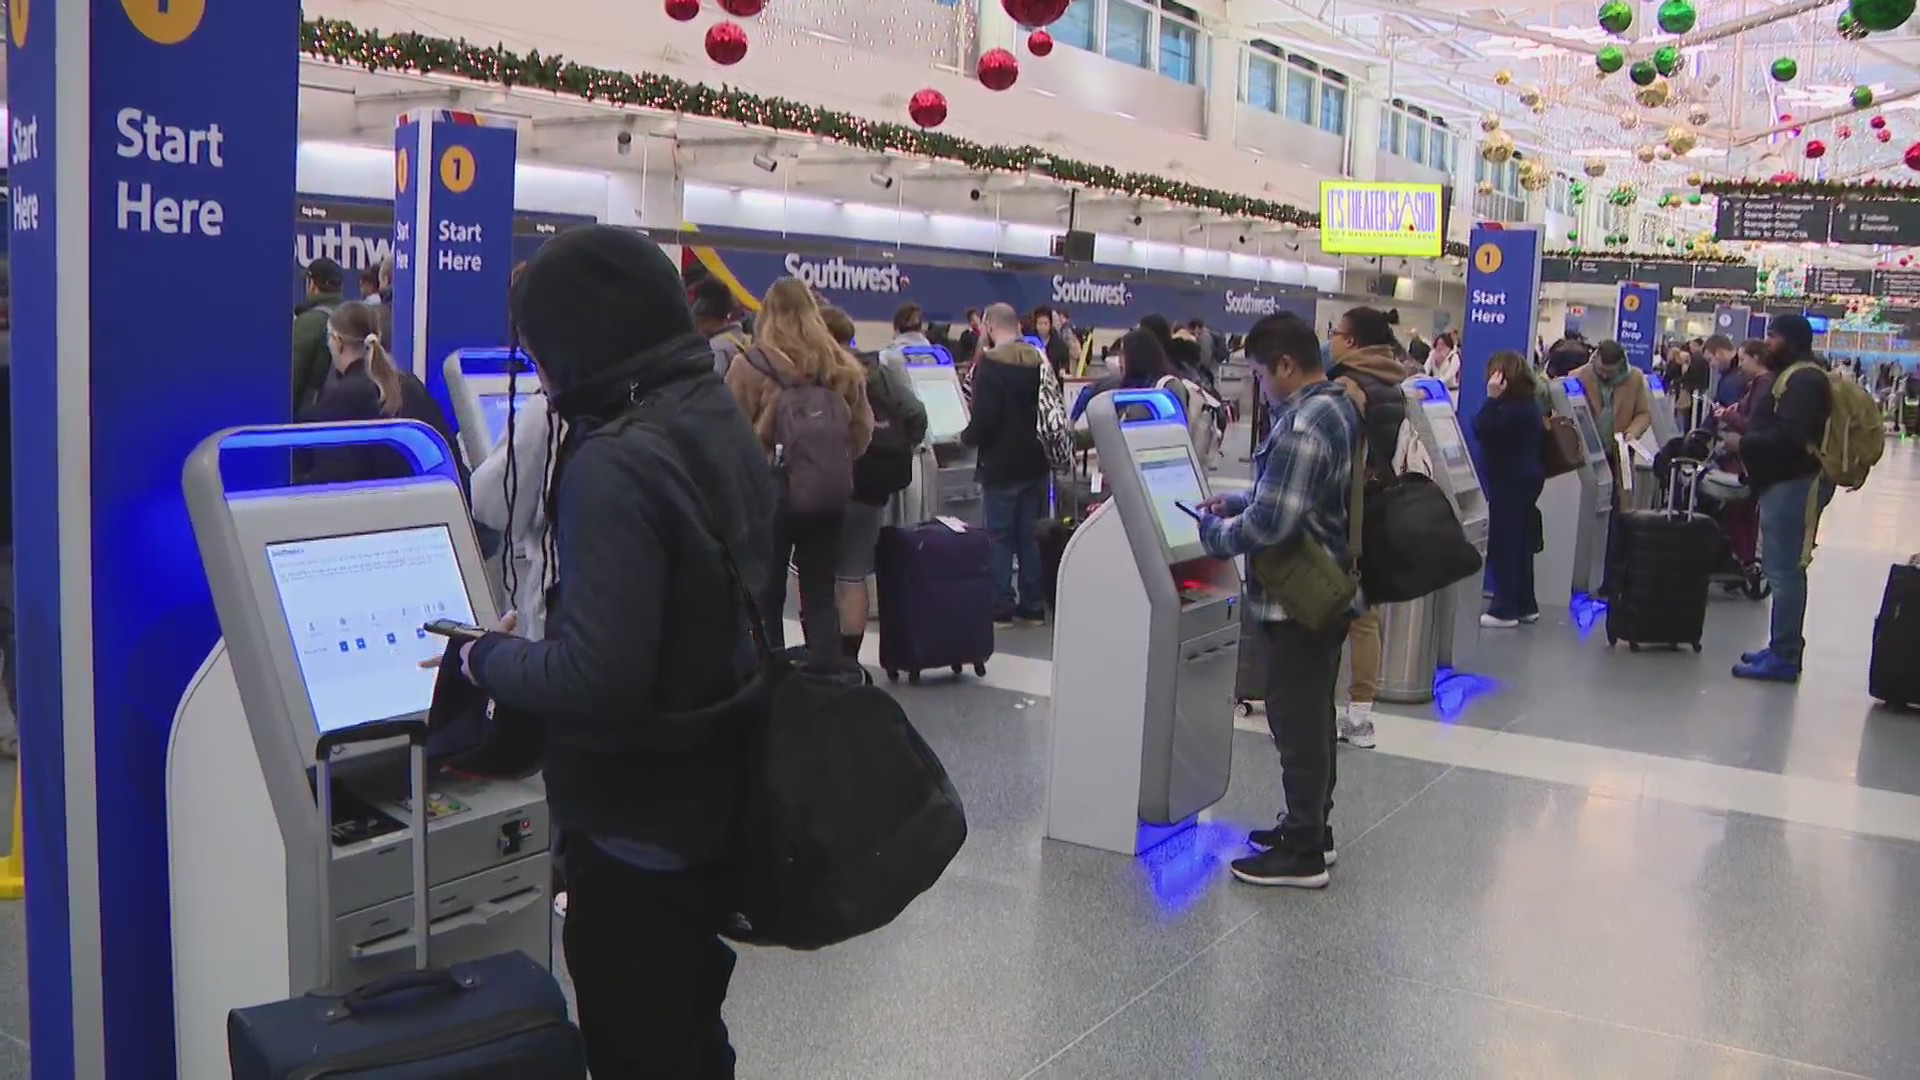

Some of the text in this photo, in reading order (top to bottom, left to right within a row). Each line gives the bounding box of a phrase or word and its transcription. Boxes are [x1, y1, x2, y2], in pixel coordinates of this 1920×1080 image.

[12, 116, 38, 165] Start
[117, 107, 223, 167] Start
[453, 157, 461, 181] 1
[13, 186, 39, 231] Here
[117, 181, 223, 236] Here
[439, 220, 482, 243] Start
[438, 249, 482, 272] Here
[1484, 251, 1491, 266] 1
[784, 252, 900, 293] Southwest
[1051, 274, 1126, 306] Southwest
[1225, 289, 1276, 315] Southwest
[1472, 289, 1506, 305] Start
[1471, 307, 1506, 324] Here
